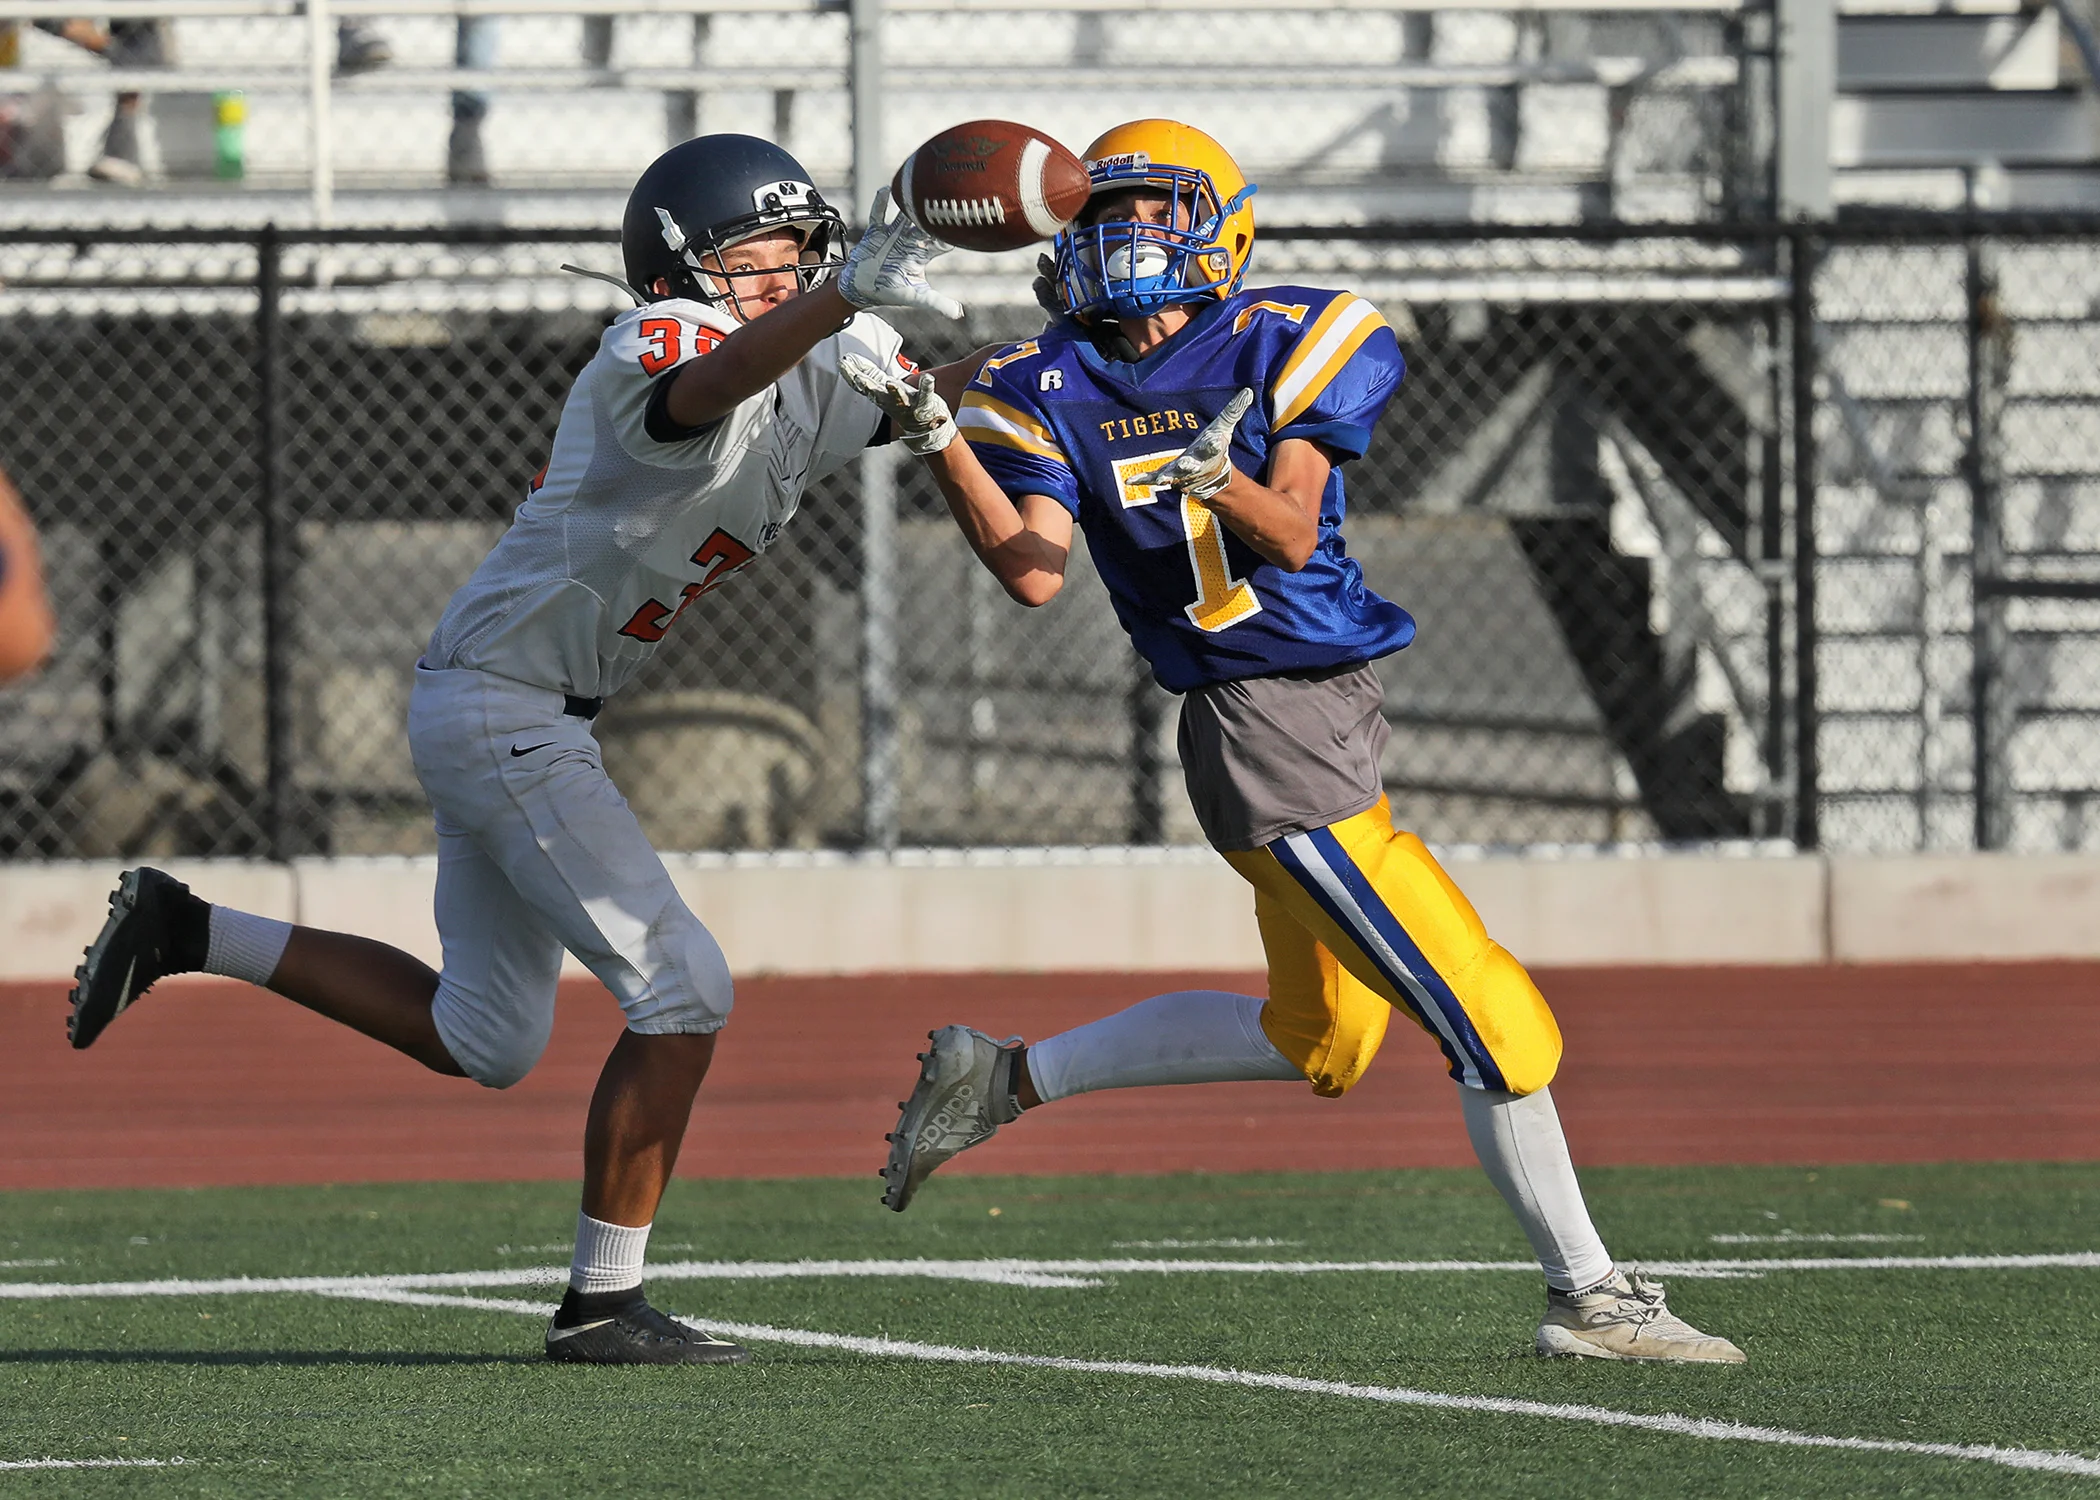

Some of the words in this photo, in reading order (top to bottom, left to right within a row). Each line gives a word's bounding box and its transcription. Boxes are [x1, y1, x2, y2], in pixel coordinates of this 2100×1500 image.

[1040, 368, 1064, 392] R
[1099, 409, 1200, 442] TIGERS
[914, 1084, 975, 1154] adidas
